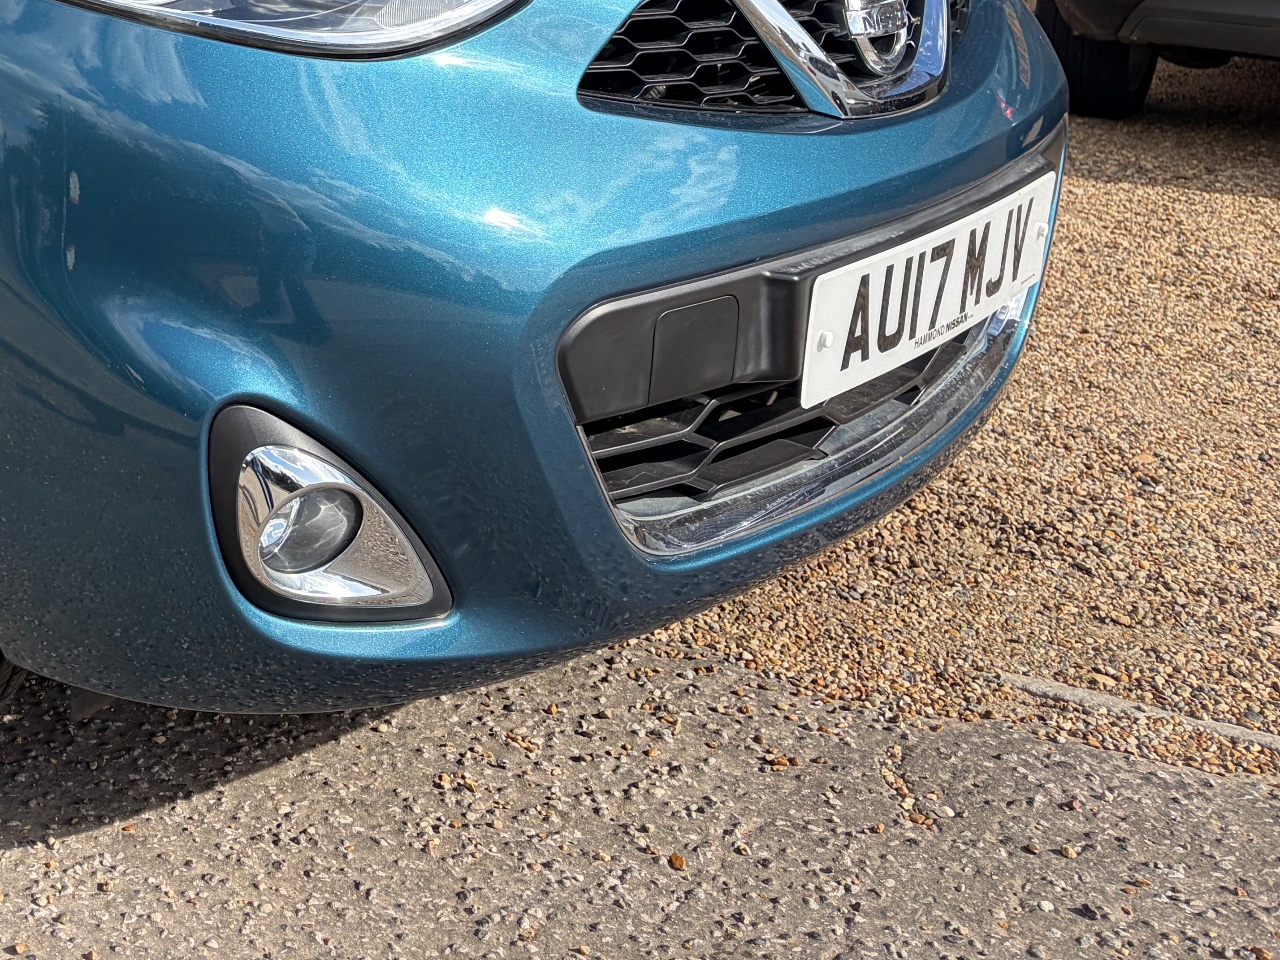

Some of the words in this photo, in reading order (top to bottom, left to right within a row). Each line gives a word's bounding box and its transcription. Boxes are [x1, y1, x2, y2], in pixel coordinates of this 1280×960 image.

[839, 237, 956, 372] AU17
[959, 196, 1035, 315] MJV
[913, 324, 945, 350] HAMMOND
[945, 311, 968, 333] NISSAN
